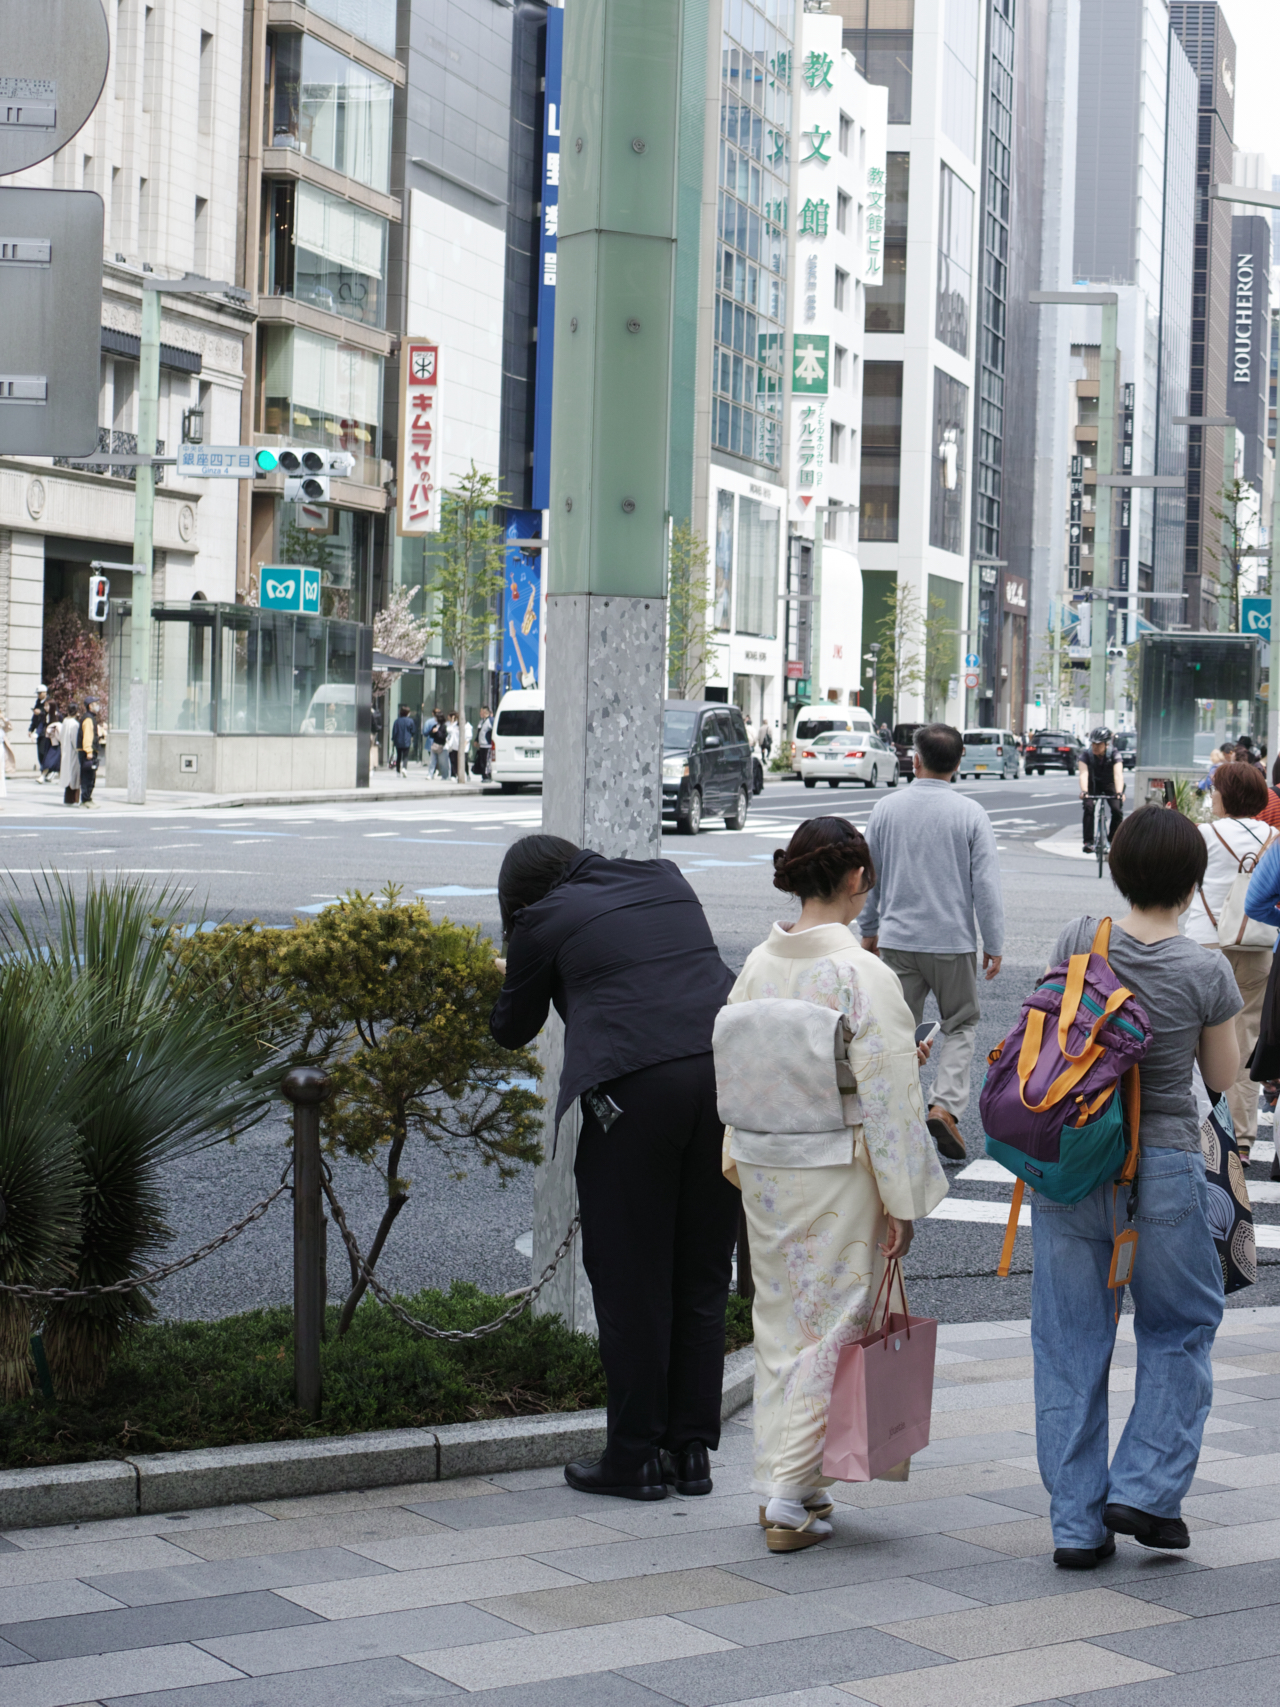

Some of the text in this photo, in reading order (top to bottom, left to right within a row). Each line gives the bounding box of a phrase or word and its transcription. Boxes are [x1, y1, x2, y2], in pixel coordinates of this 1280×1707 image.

[799, 50, 834, 237] 教文館
[867, 166, 886, 274] 教文館ビル
[794, 343, 826, 385] 本
[1233, 253, 1254, 383] BOUCHERON
[182, 452, 250, 467] 銀座四丁目
[201, 466, 229, 475] Ginza 4
[409, 393, 434, 521] キムラヤのパン
[800, 405, 817, 484] ナルニア国
